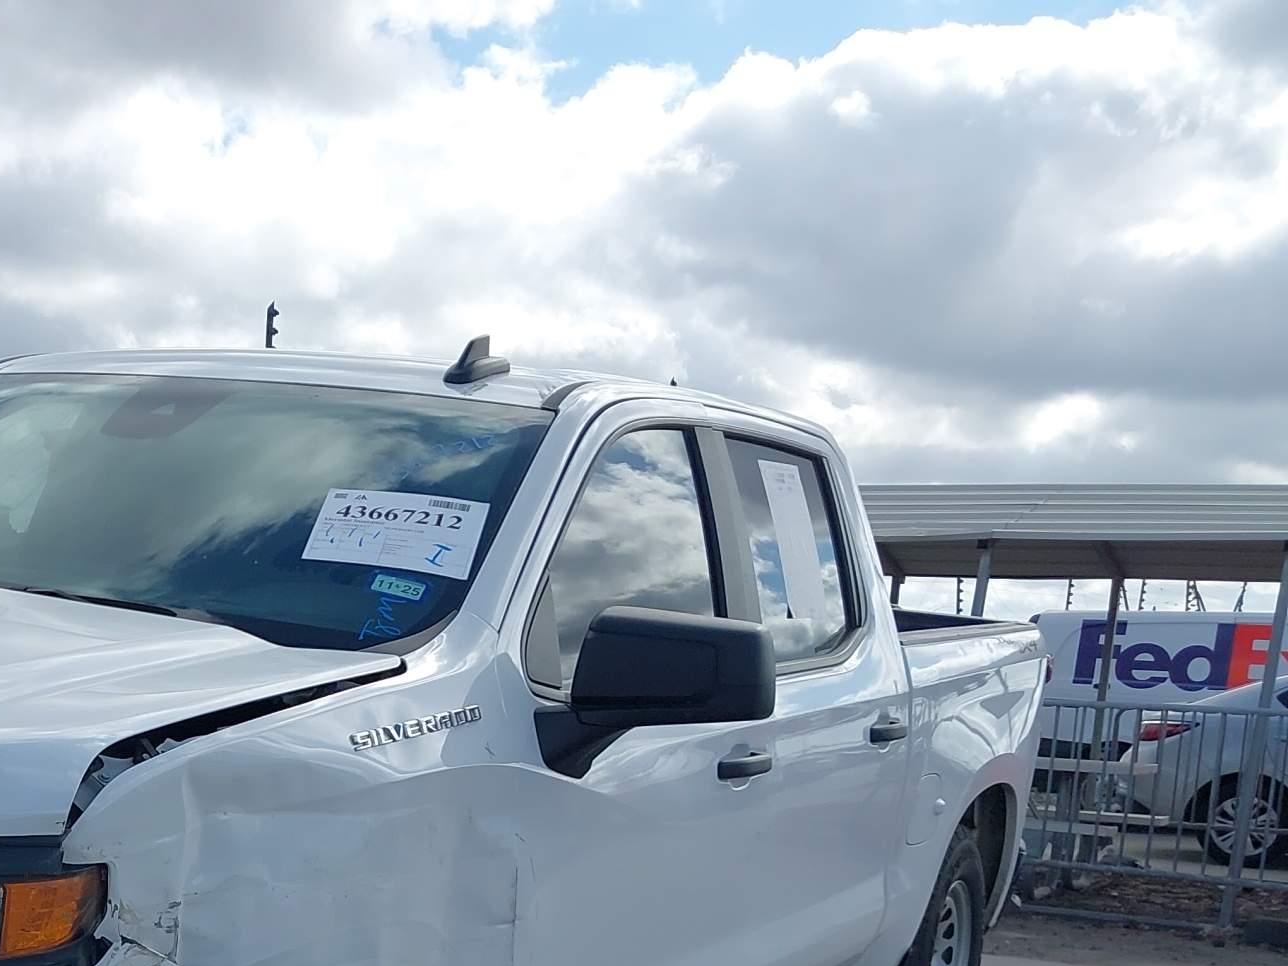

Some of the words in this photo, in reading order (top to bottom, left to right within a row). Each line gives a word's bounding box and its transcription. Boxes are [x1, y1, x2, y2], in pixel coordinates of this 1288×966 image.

[335, 503, 464, 530] 43667212
[1072, 619, 1288, 691] FedE
[349, 704, 483, 752] SILVERADO
